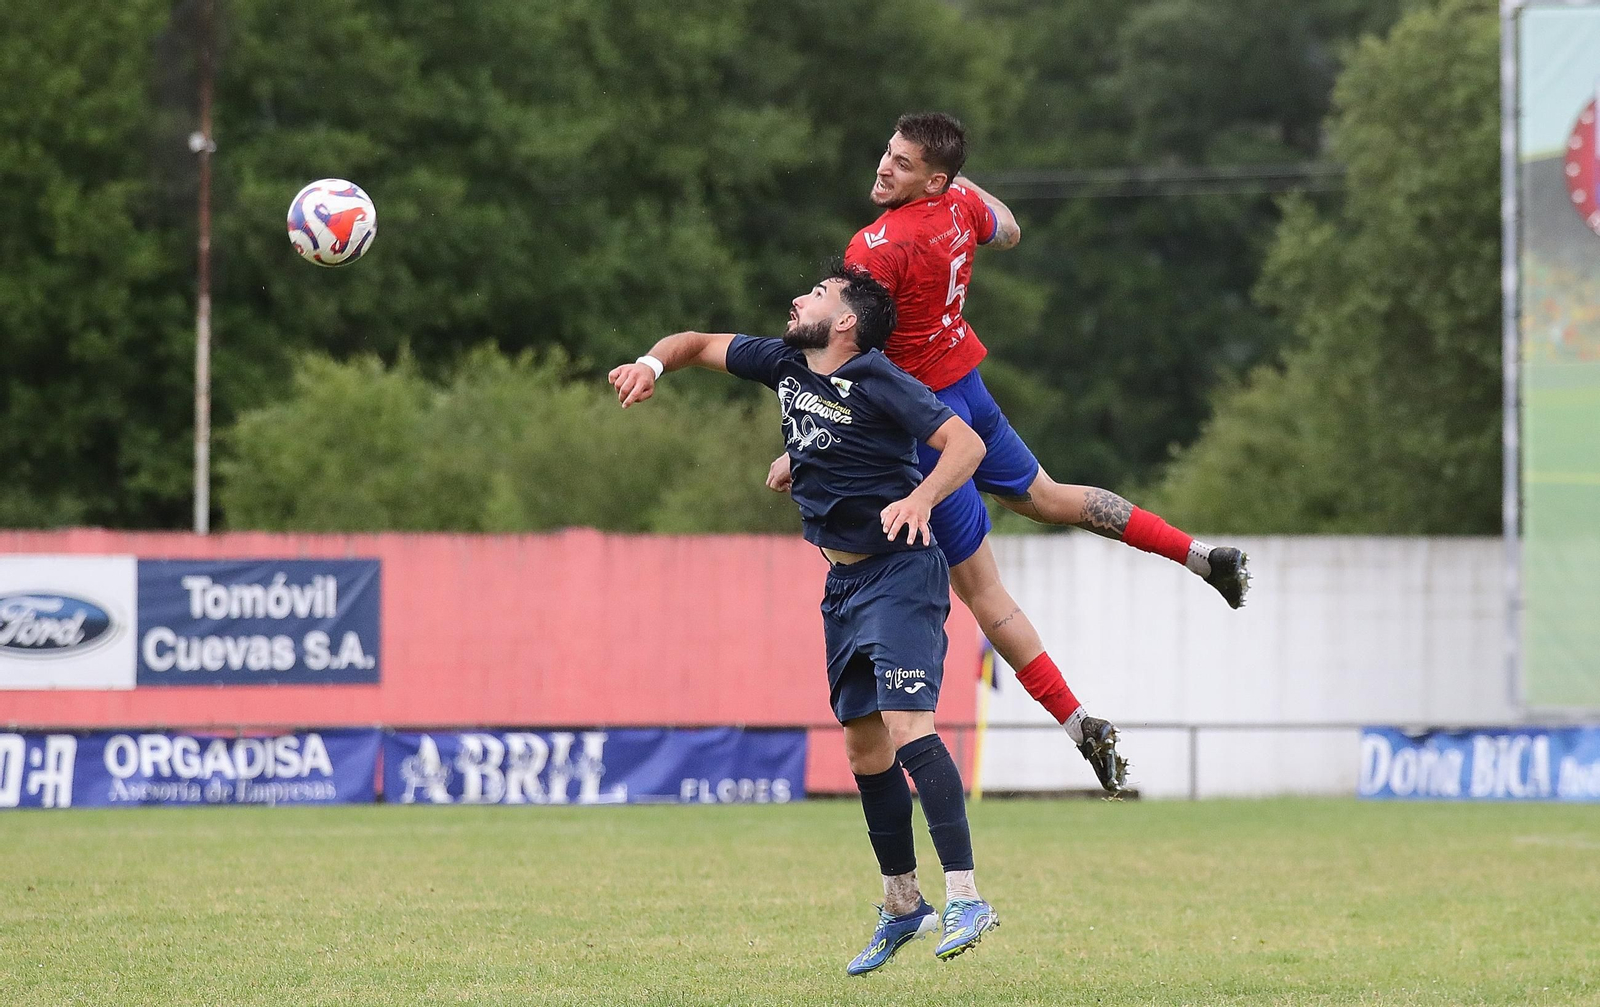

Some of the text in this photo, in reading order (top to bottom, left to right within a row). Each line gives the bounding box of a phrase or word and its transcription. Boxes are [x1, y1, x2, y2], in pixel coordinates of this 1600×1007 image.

[181, 572, 338, 620] Tomóvil
[0, 597, 87, 647] Ford
[142, 626, 376, 672] Cuevas S.A.
[103, 734, 334, 779] ORGADISA
[680, 777, 791, 804] FLORES
